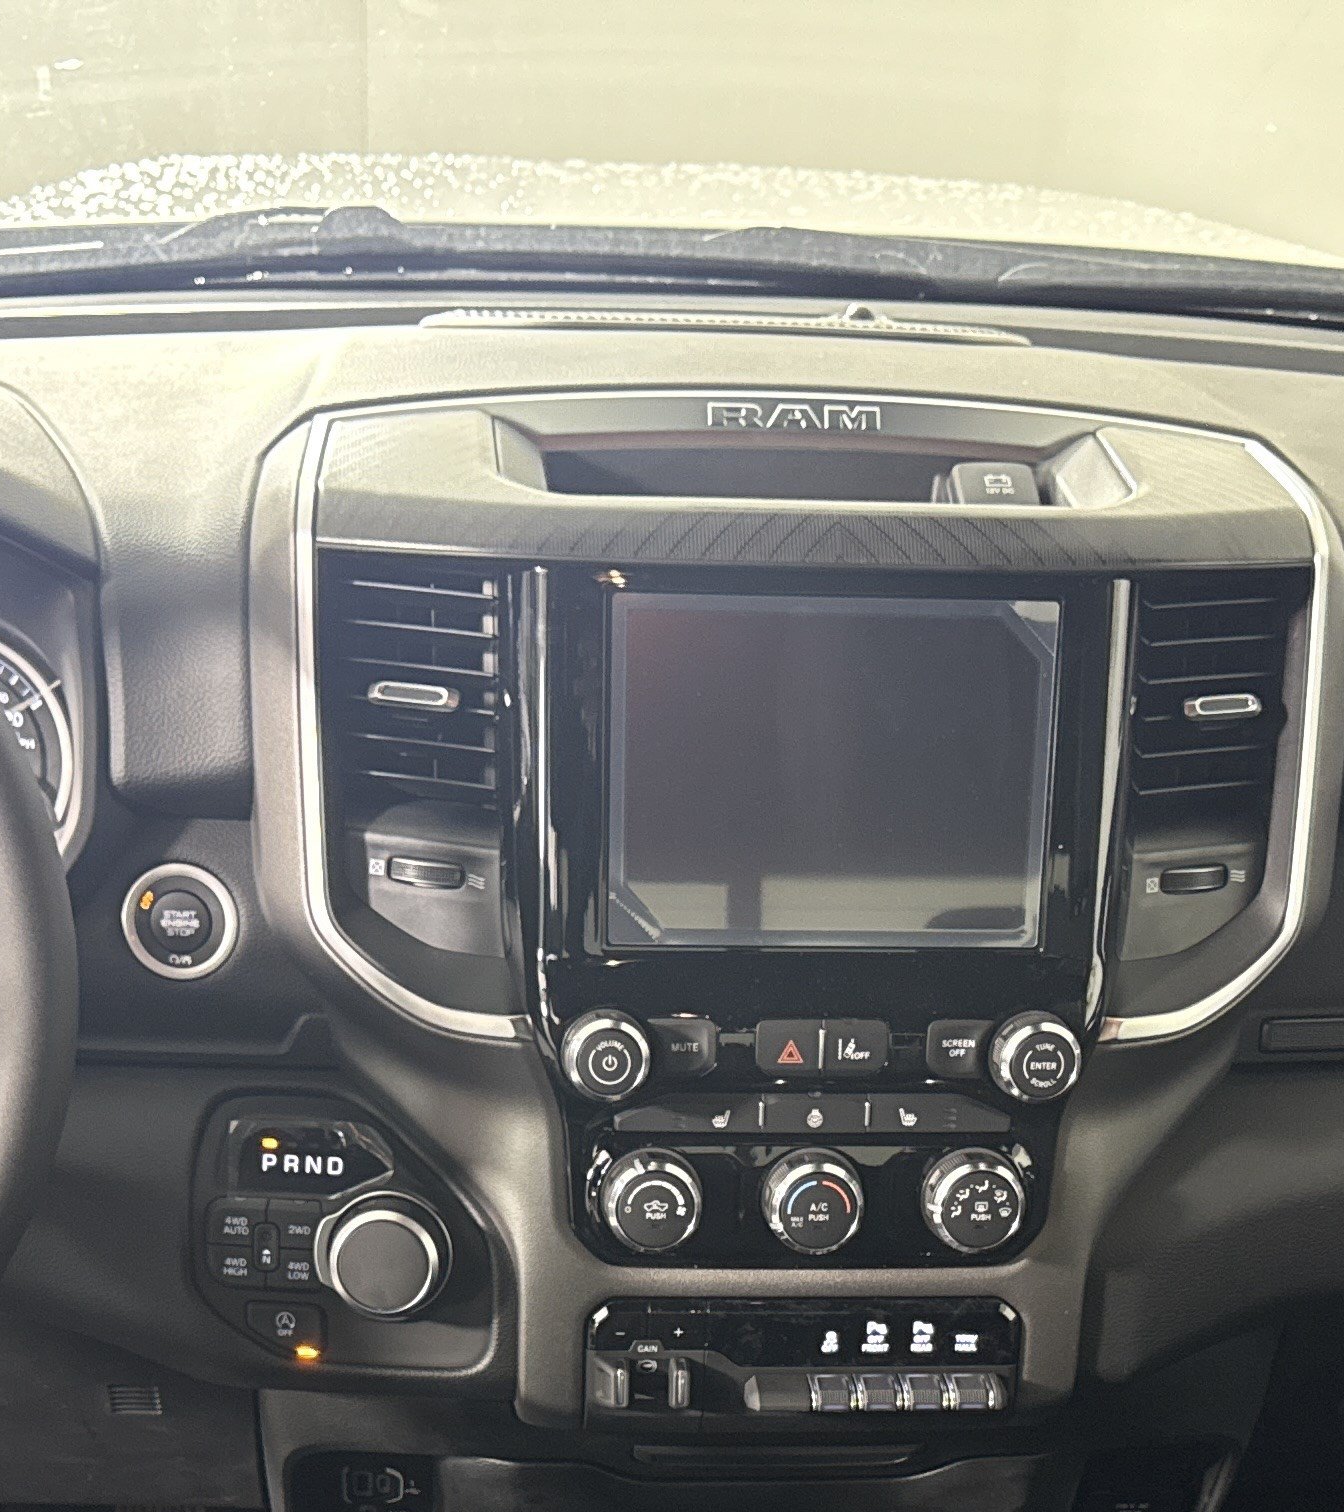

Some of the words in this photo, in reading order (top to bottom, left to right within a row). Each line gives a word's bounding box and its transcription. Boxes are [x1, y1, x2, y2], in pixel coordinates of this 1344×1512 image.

[707, 400, 881, 431] RAM
[166, 927, 196, 937] STOP
[596, 1040, 625, 1052] VOLUME
[671, 1042, 699, 1053] MUTE
[941, 1039, 976, 1049] SCREEN
[854, 1051, 871, 1060] OFF
[948, 1048, 966, 1058] OFF
[1029, 1061, 1058, 1071] ENTER
[809, 1201, 829, 1212] A/C
[225, 1216, 248, 1226] 4WD
[645, 1212, 667, 1220] PUSH
[808, 1213, 830, 1222] PUSH
[970, 1213, 992, 1222] PUSH
[223, 1225, 250, 1236] AUTO
[287, 1225, 312, 1236] 2WD
[223, 1257, 248, 1267] 4WD
[261, 1254, 272, 1265] N
[222, 1266, 248, 1277] HIGH
[287, 1261, 310, 1272] 4WD
[287, 1271, 311, 1281] LOW
[637, 1344, 659, 1353] GAIN
